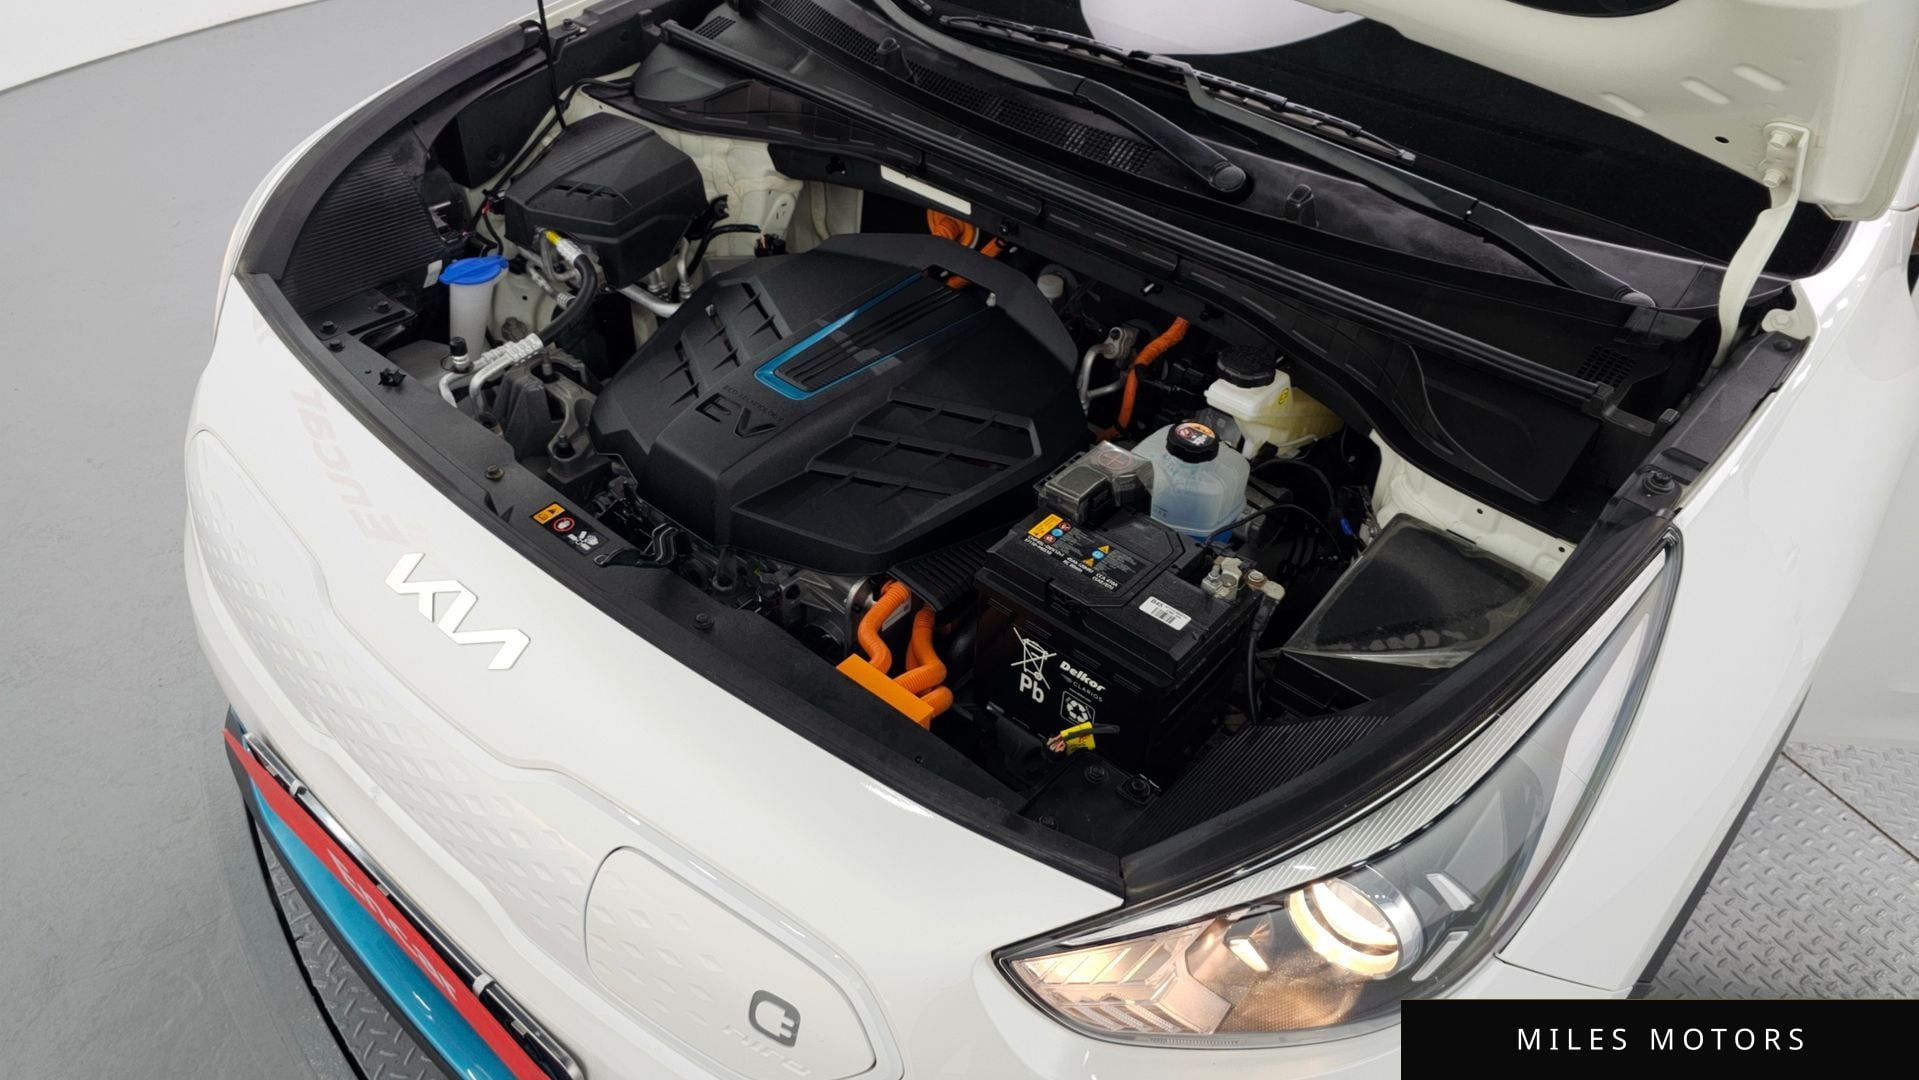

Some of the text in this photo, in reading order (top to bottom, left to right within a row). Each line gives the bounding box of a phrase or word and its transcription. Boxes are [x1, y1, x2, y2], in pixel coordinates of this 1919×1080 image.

[695, 392, 777, 439] EV
[385, 552, 531, 671] KIA
[1019, 672, 1045, 703] Pb
[1060, 660, 1106, 692] Delkor
[1073, 681, 1103, 702] CLARIOS
